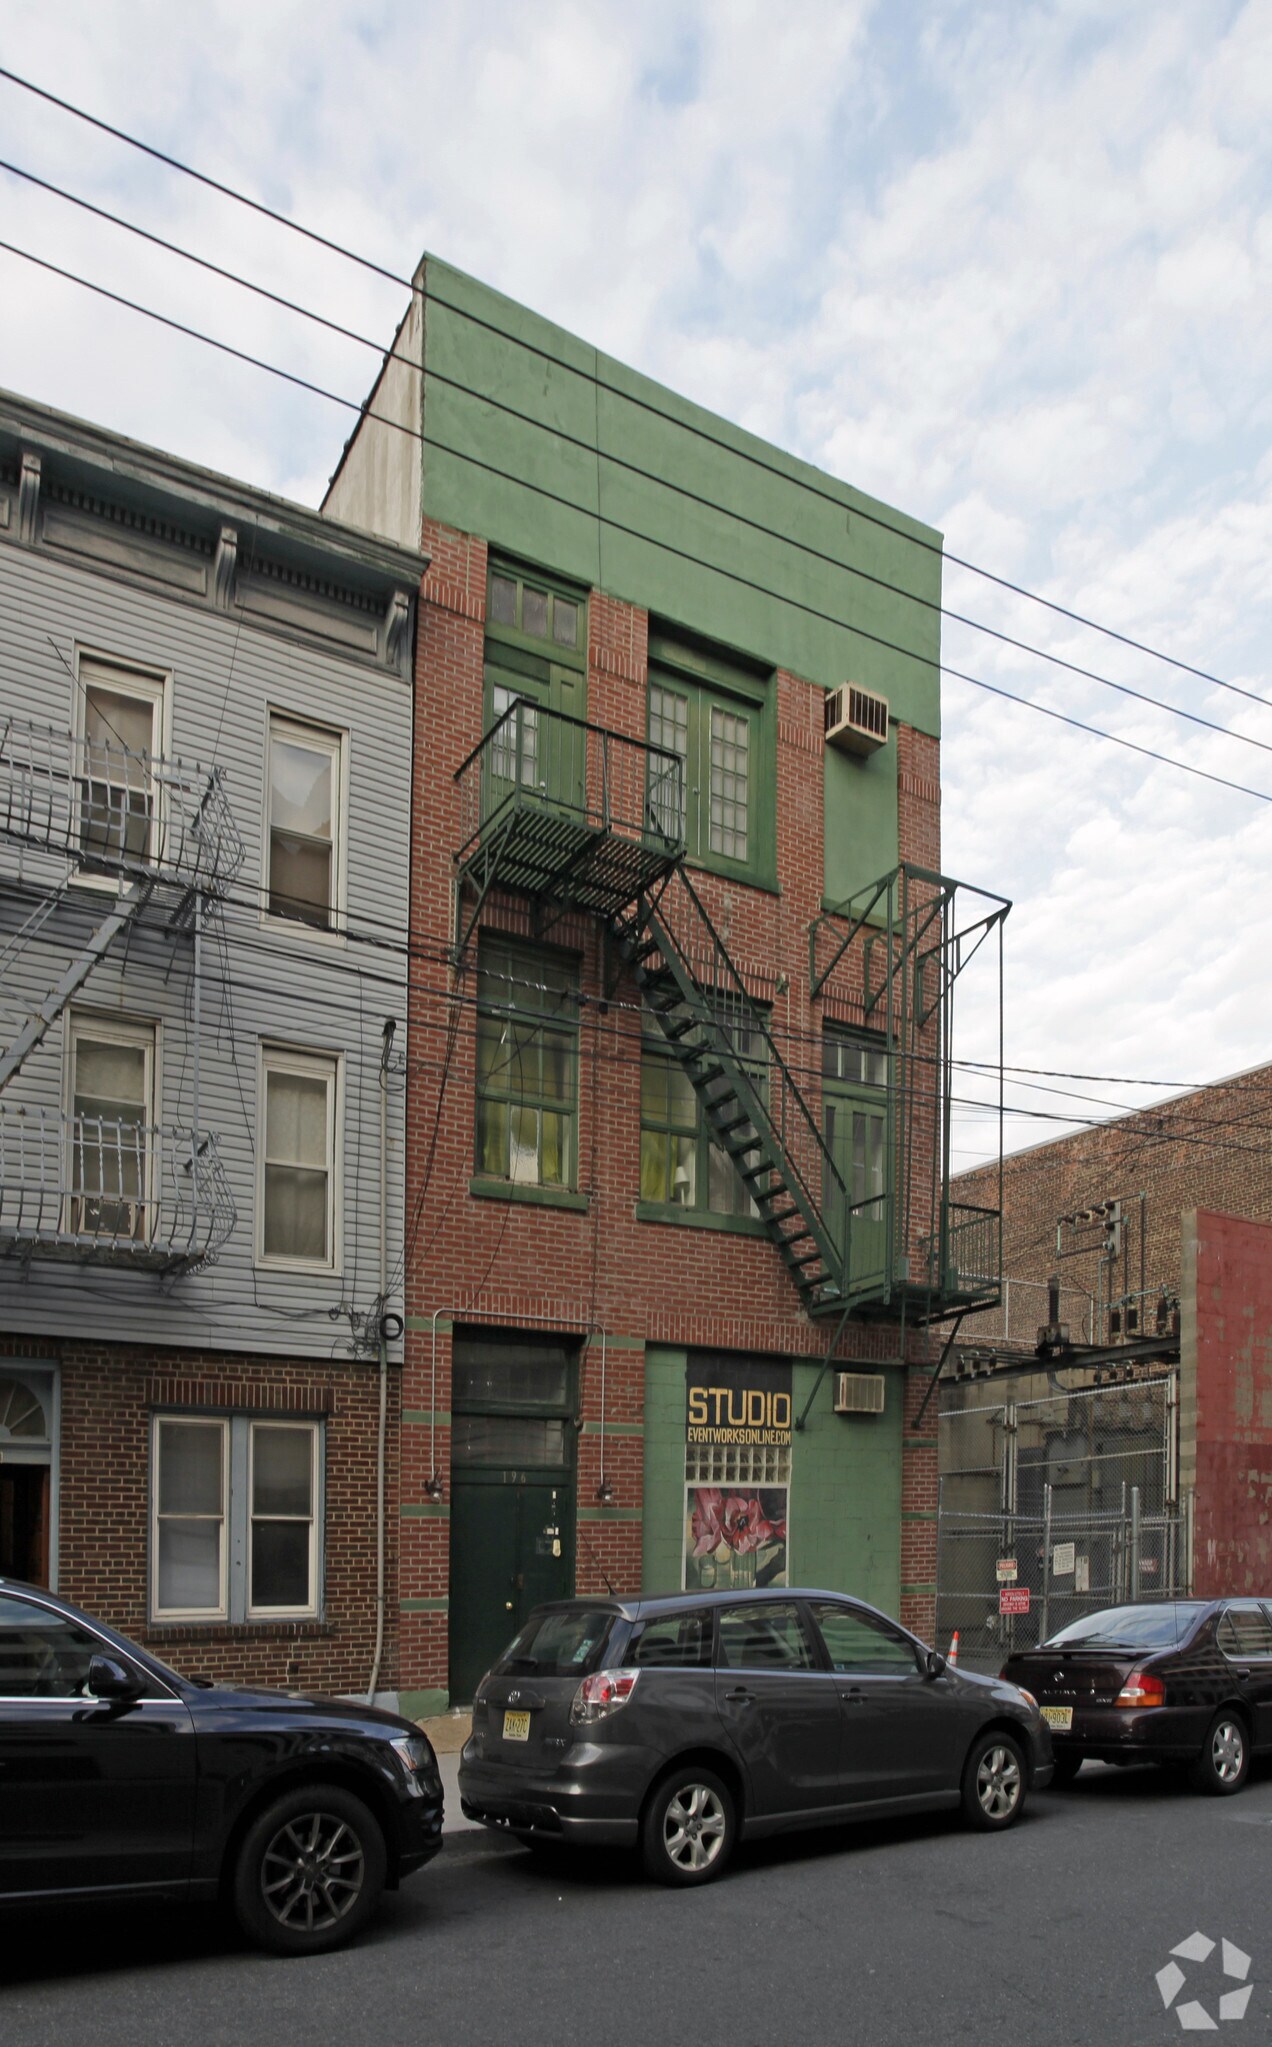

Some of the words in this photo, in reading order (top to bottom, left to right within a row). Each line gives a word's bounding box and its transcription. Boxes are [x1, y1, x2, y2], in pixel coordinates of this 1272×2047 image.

[688, 1387, 791, 1429] STUDIO
[688, 1427, 791, 1445] EVENTWORKSONLINE.COM
[503, 1471, 526, 1483] 196
